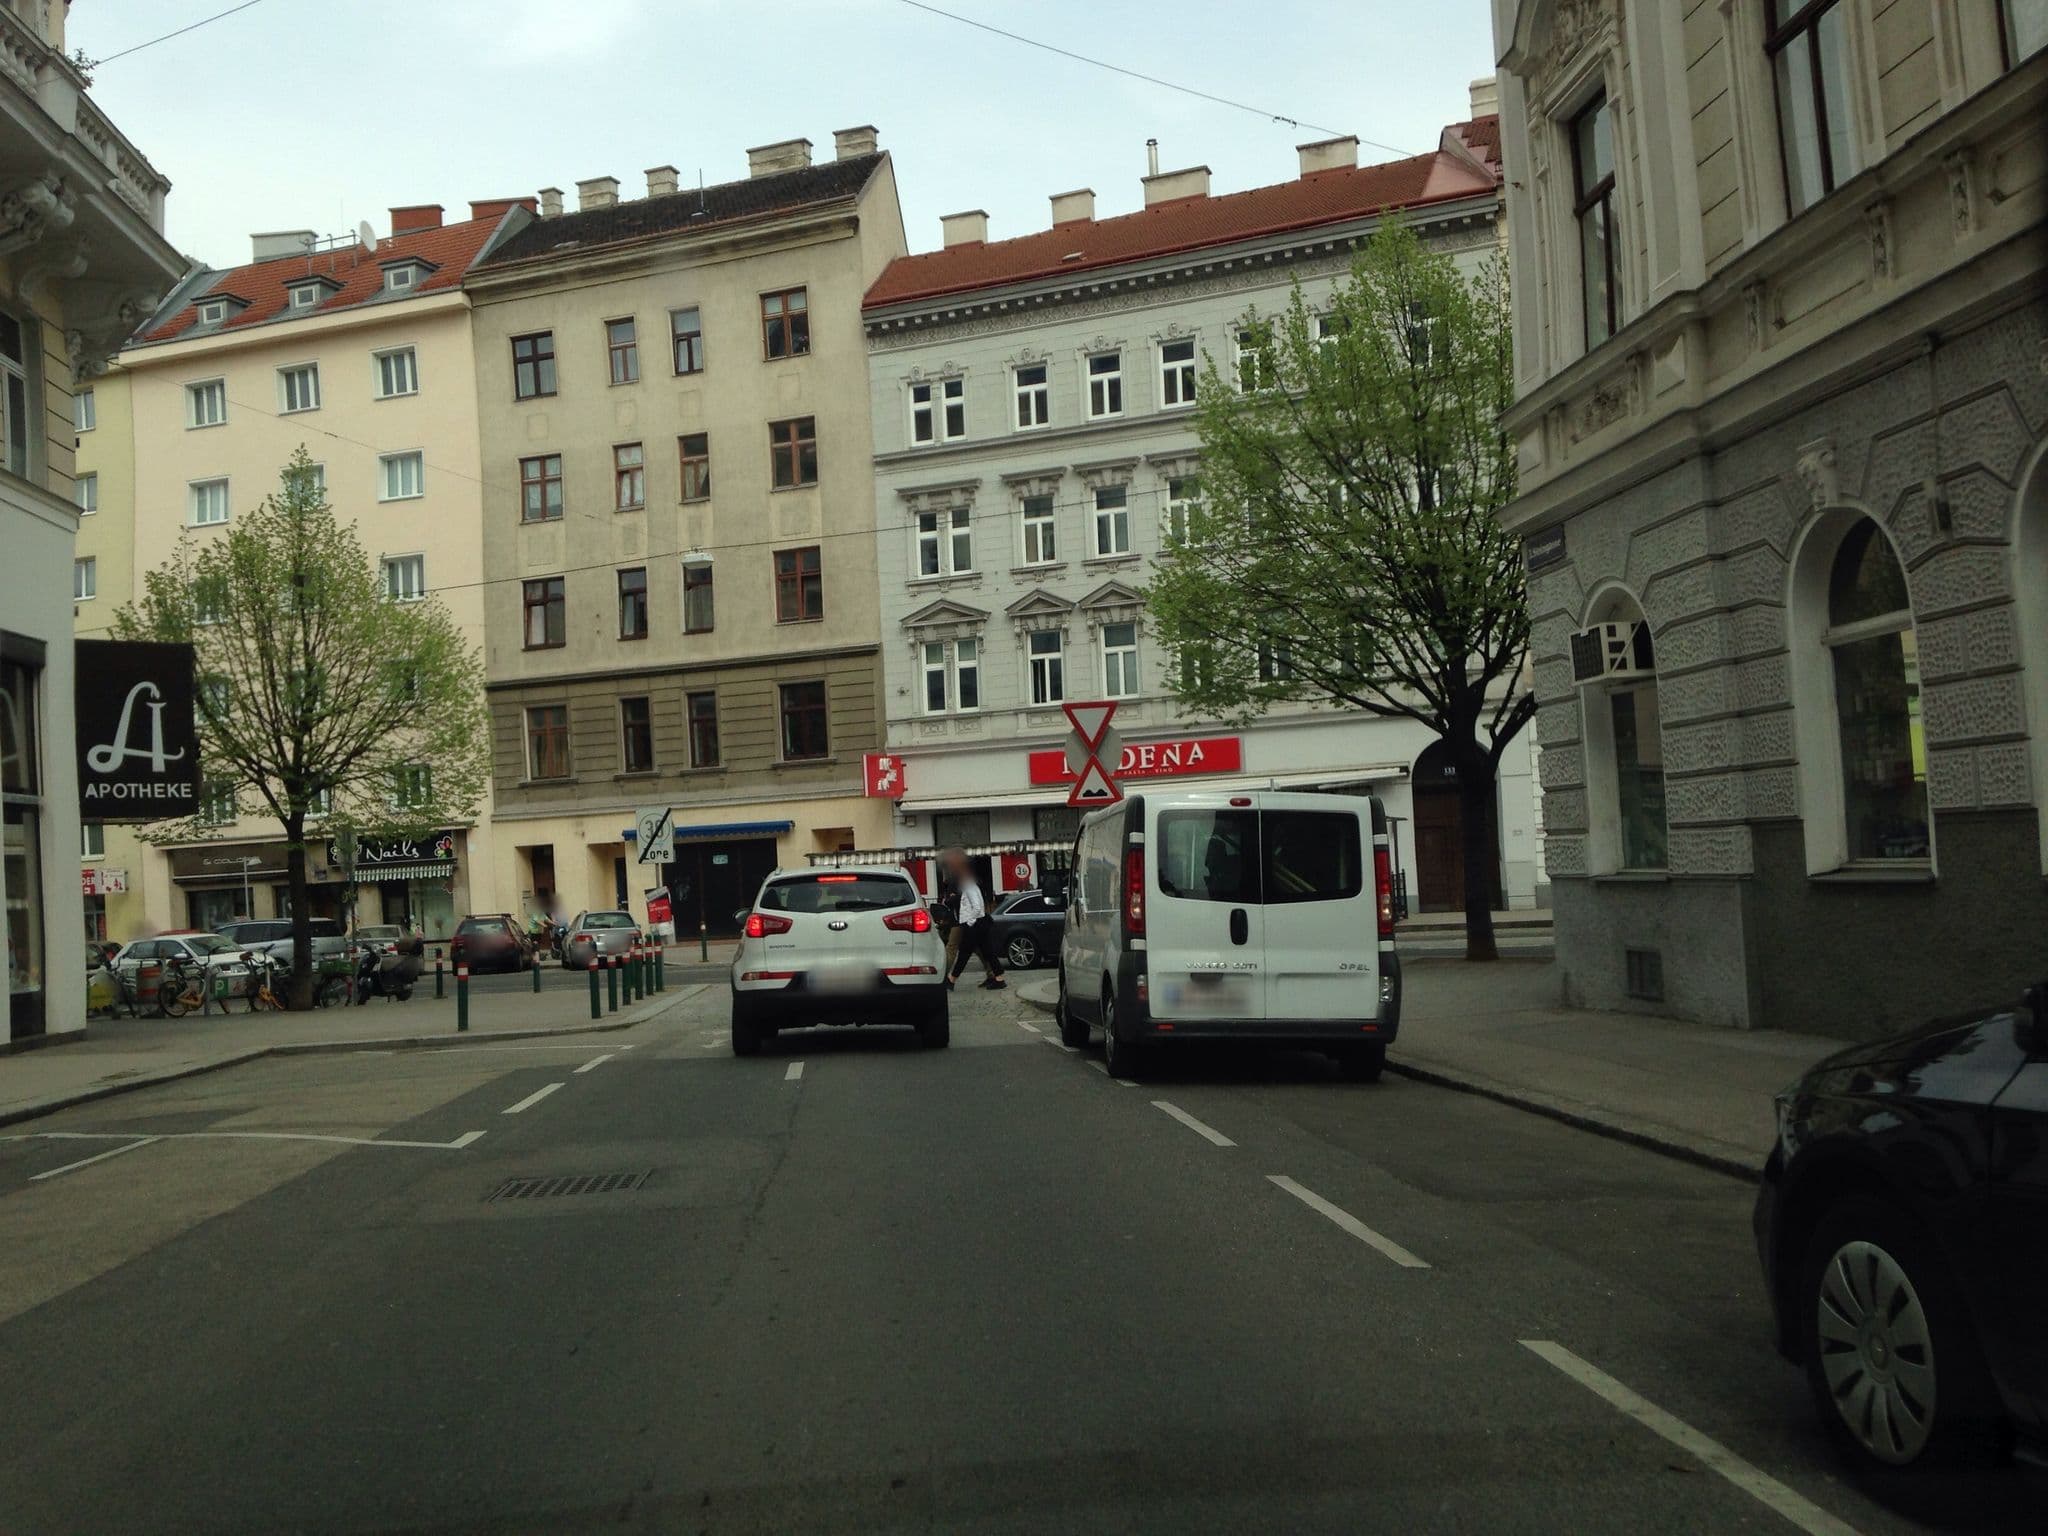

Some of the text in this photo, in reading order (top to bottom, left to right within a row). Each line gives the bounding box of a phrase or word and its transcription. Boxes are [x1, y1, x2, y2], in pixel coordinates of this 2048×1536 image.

[1062, 742, 1205, 774] DENA
[85, 782, 193, 800] APOTHEKE
[365, 839, 420, 862] Nails
[1339, 962, 1371, 971] OPEL
